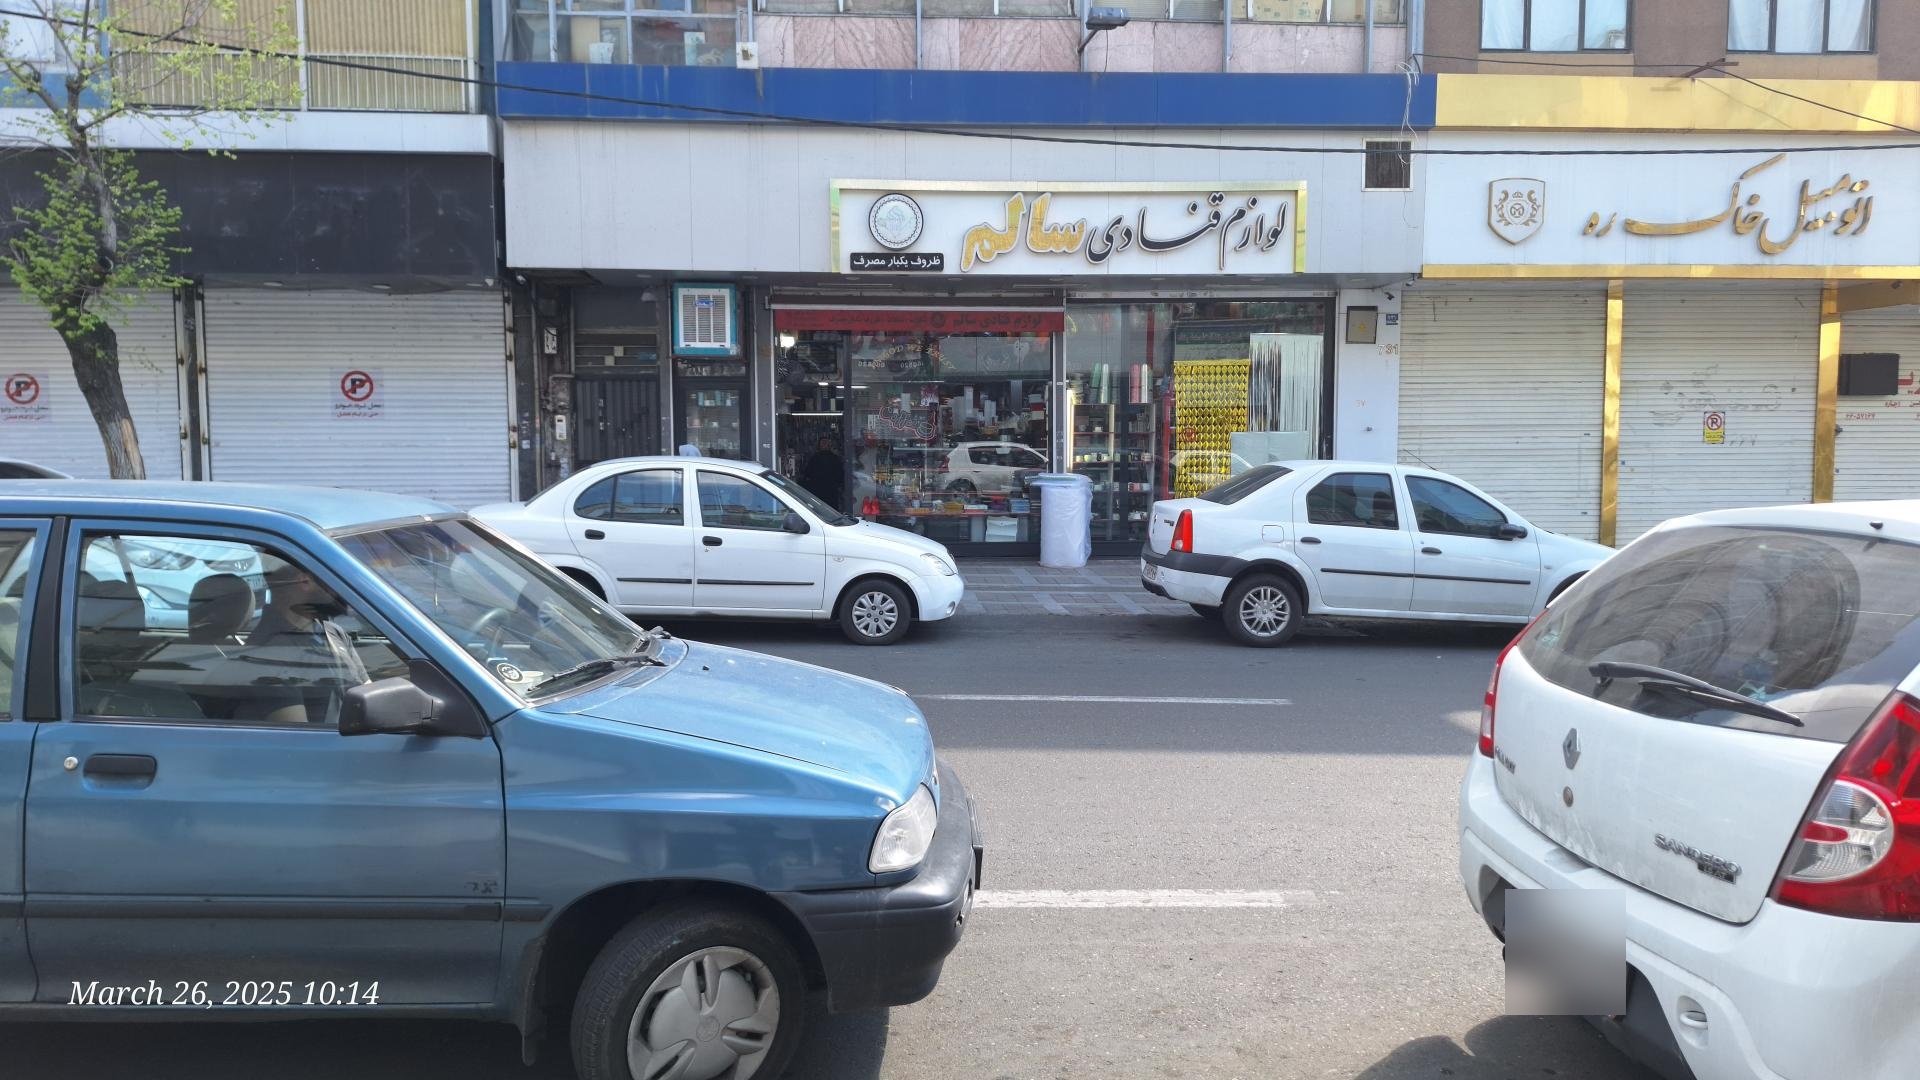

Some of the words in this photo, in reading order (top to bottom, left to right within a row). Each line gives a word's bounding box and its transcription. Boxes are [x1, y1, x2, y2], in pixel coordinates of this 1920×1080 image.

[960, 191, 1087, 273] سالم
[1085, 192, 1226, 265] قنادی
[1218, 195, 1289, 271] لوازم
[853, 255, 886, 268] مصرف
[887, 255, 909, 268] یکبار
[910, 255, 941, 268] ظروف
